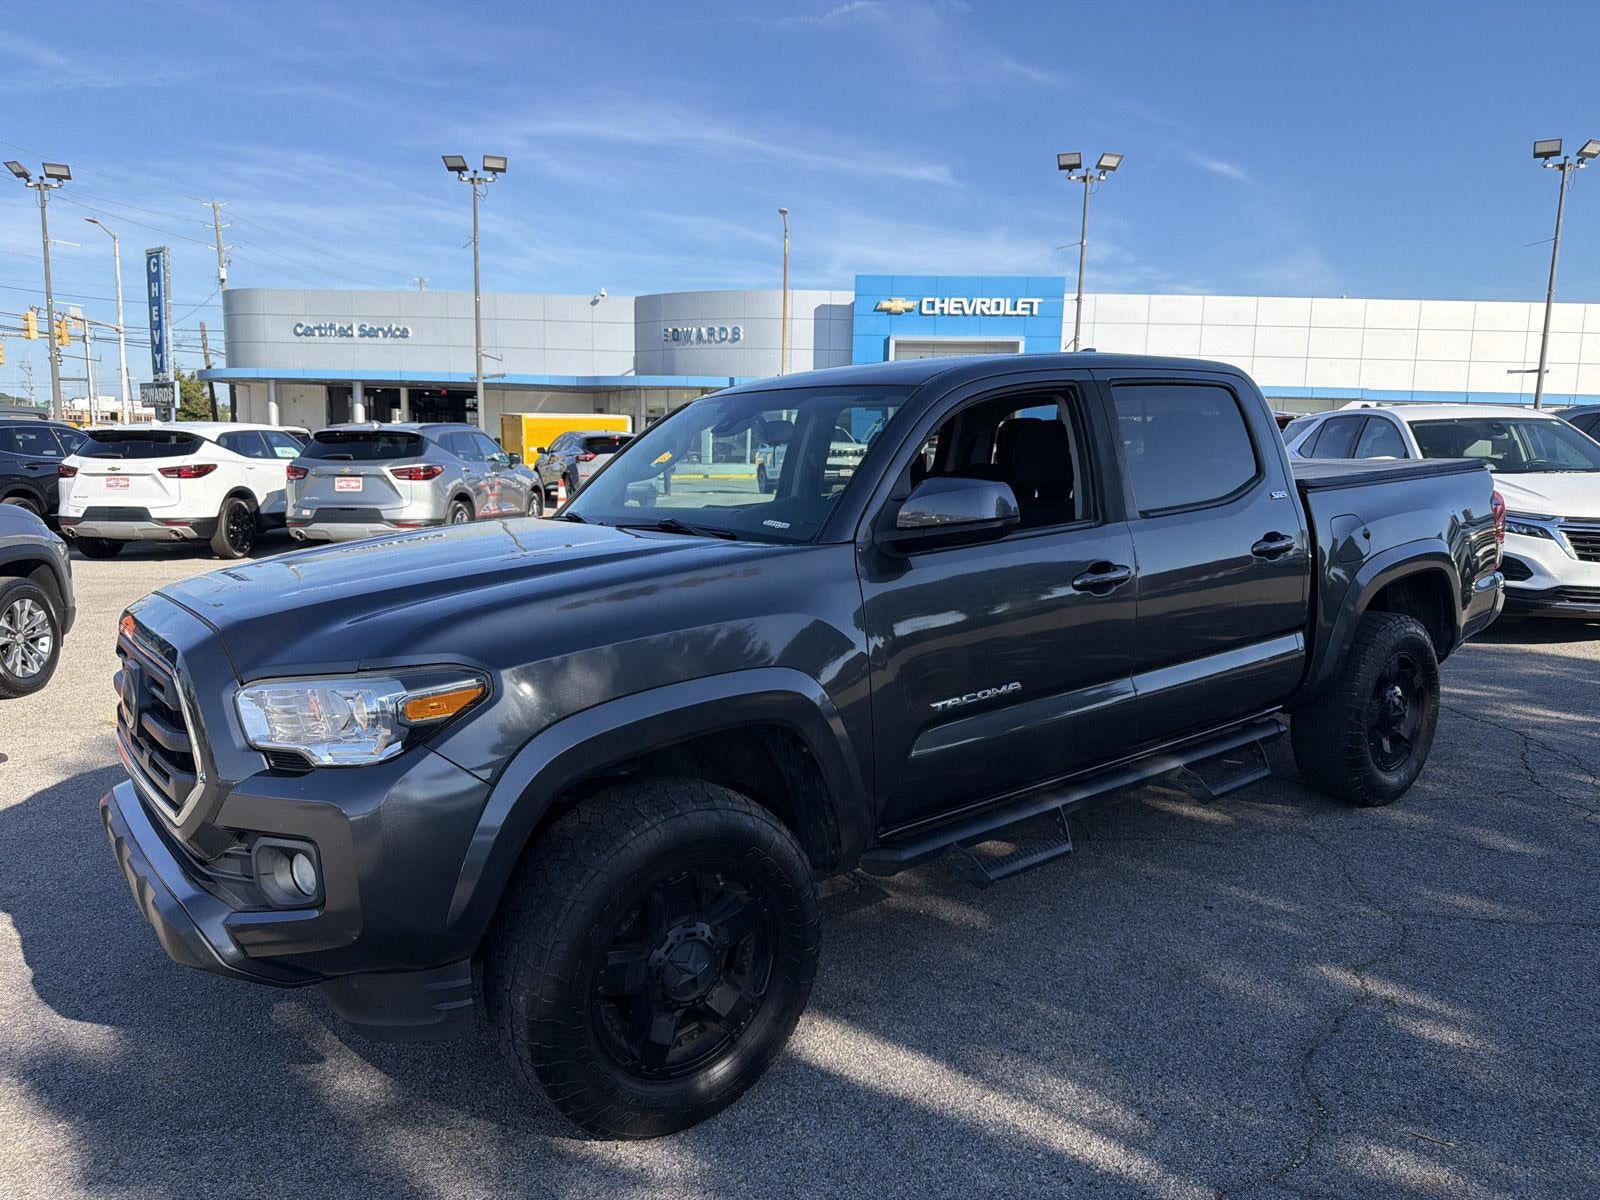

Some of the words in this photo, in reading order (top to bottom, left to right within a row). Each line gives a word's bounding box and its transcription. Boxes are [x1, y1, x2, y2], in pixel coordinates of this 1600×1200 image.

[150, 258, 161, 368] CHEVY
[920, 297, 1043, 316] CHEVROLET
[293, 322, 354, 338] Certified
[358, 323, 411, 339] Service
[663, 326, 743, 343] EDWARDS
[141, 388, 173, 402] EDWARDS
[930, 681, 1022, 711] TACOMA
